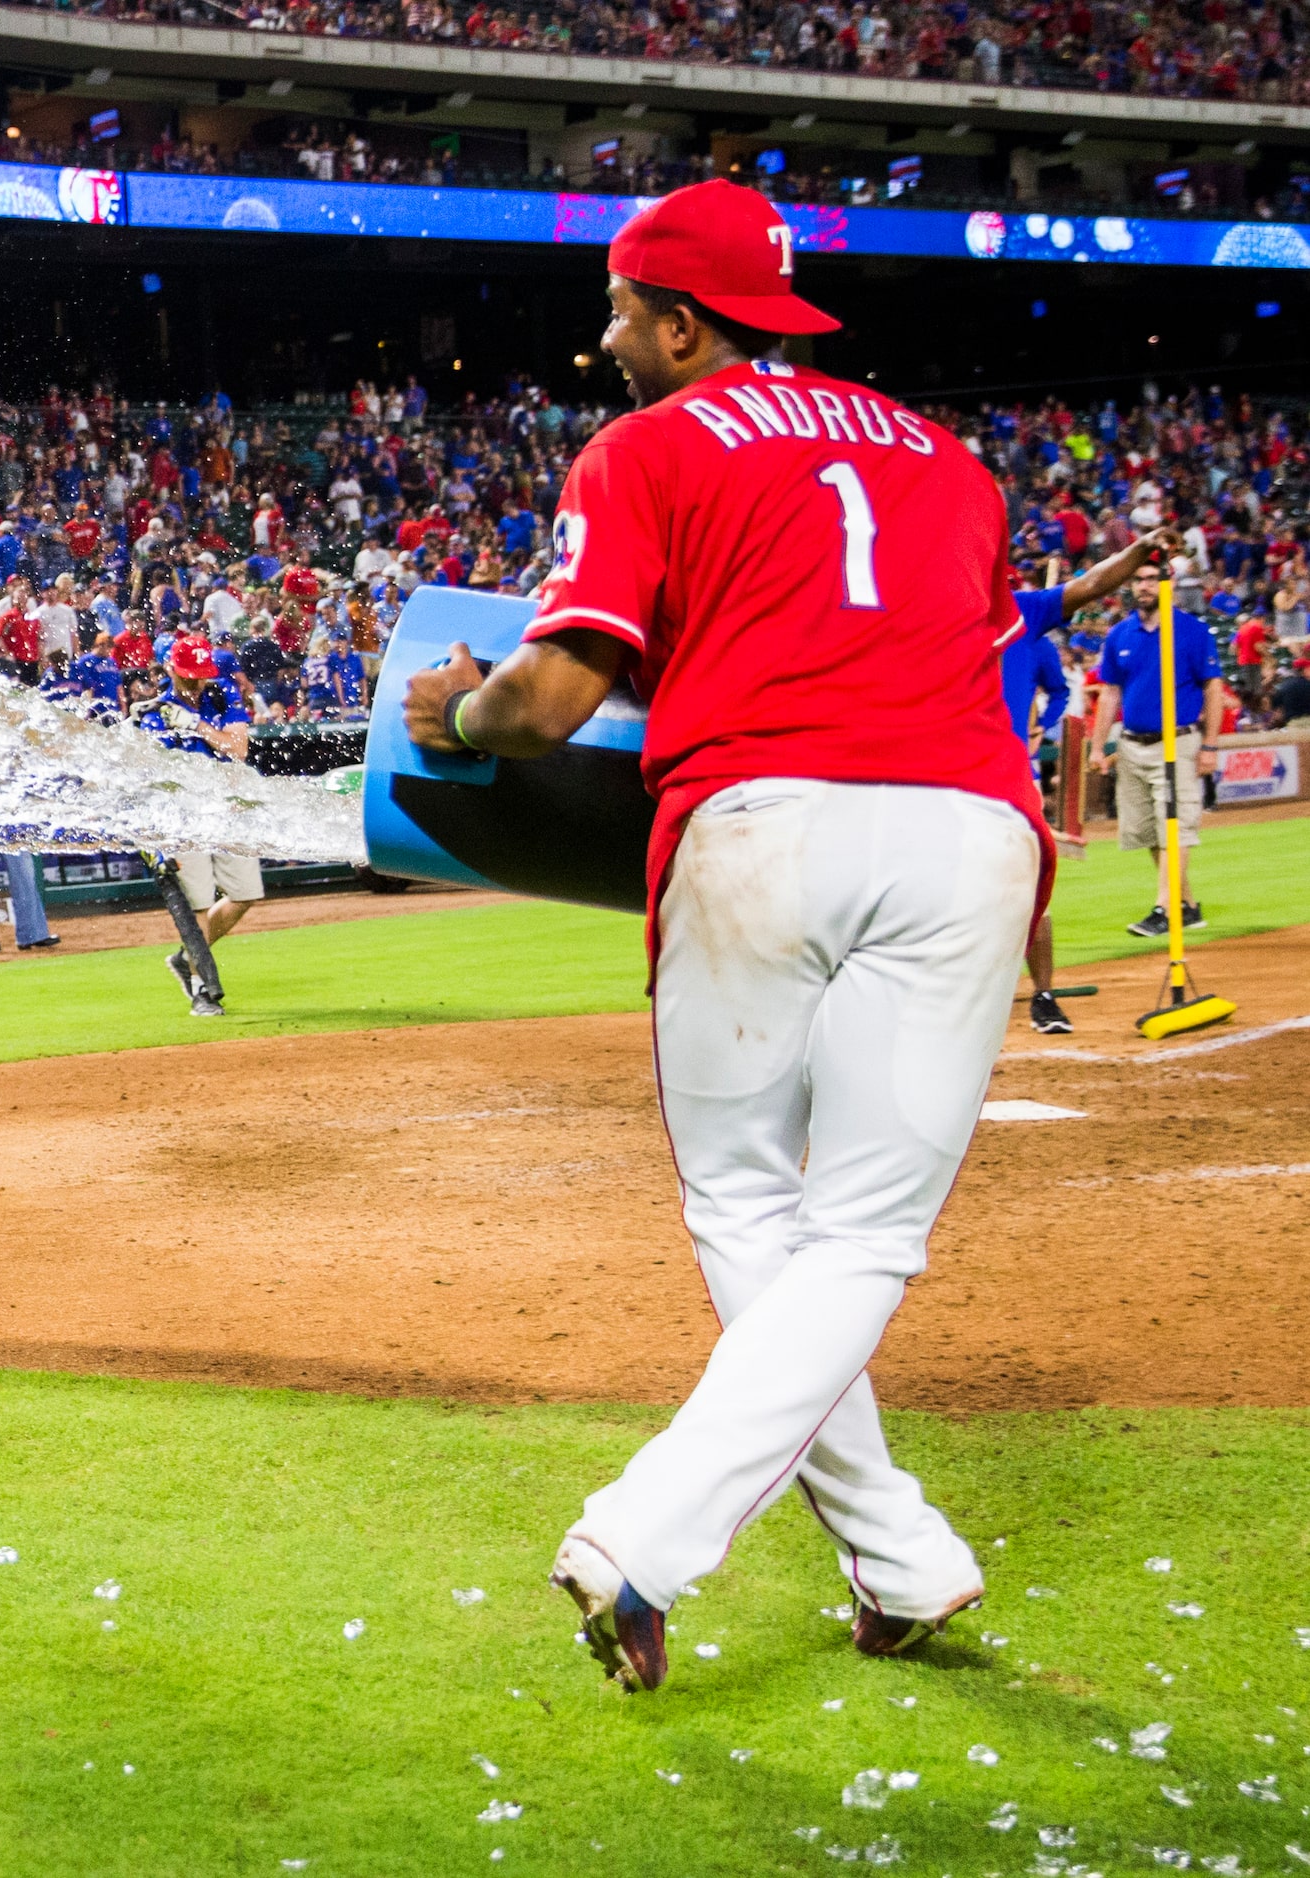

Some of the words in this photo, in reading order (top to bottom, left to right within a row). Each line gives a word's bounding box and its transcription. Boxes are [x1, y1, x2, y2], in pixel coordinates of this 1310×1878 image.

[767, 224, 793, 275] T
[682, 384, 935, 456] ANDRUS
[815, 460, 886, 611] 1
[307, 664, 328, 686] 23
